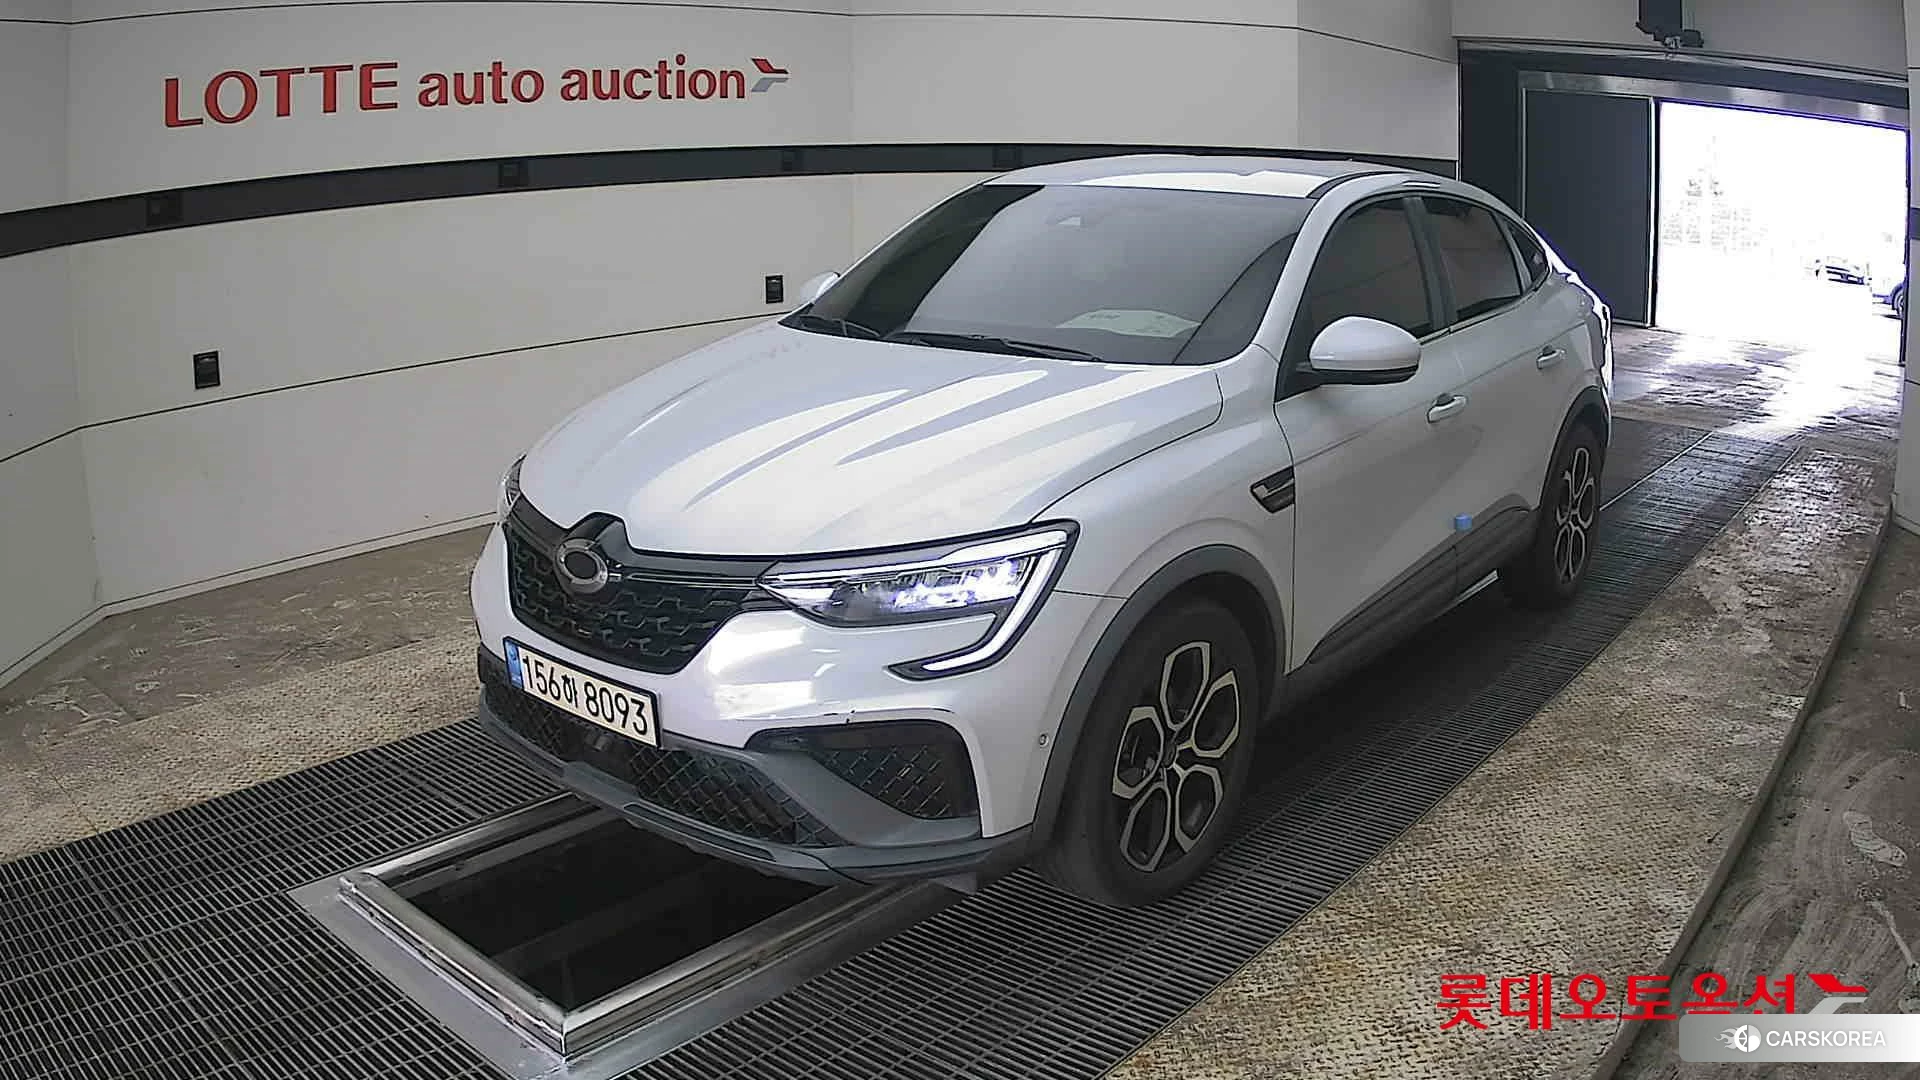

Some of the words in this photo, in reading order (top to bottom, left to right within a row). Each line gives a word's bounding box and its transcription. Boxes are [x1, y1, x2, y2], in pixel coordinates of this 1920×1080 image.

[164, 62, 399, 128] LOTTE
[418, 61, 545, 107] auto
[560, 54, 746, 101] auction
[522, 655, 578, 708] 156하
[584, 681, 648, 736] 8093
